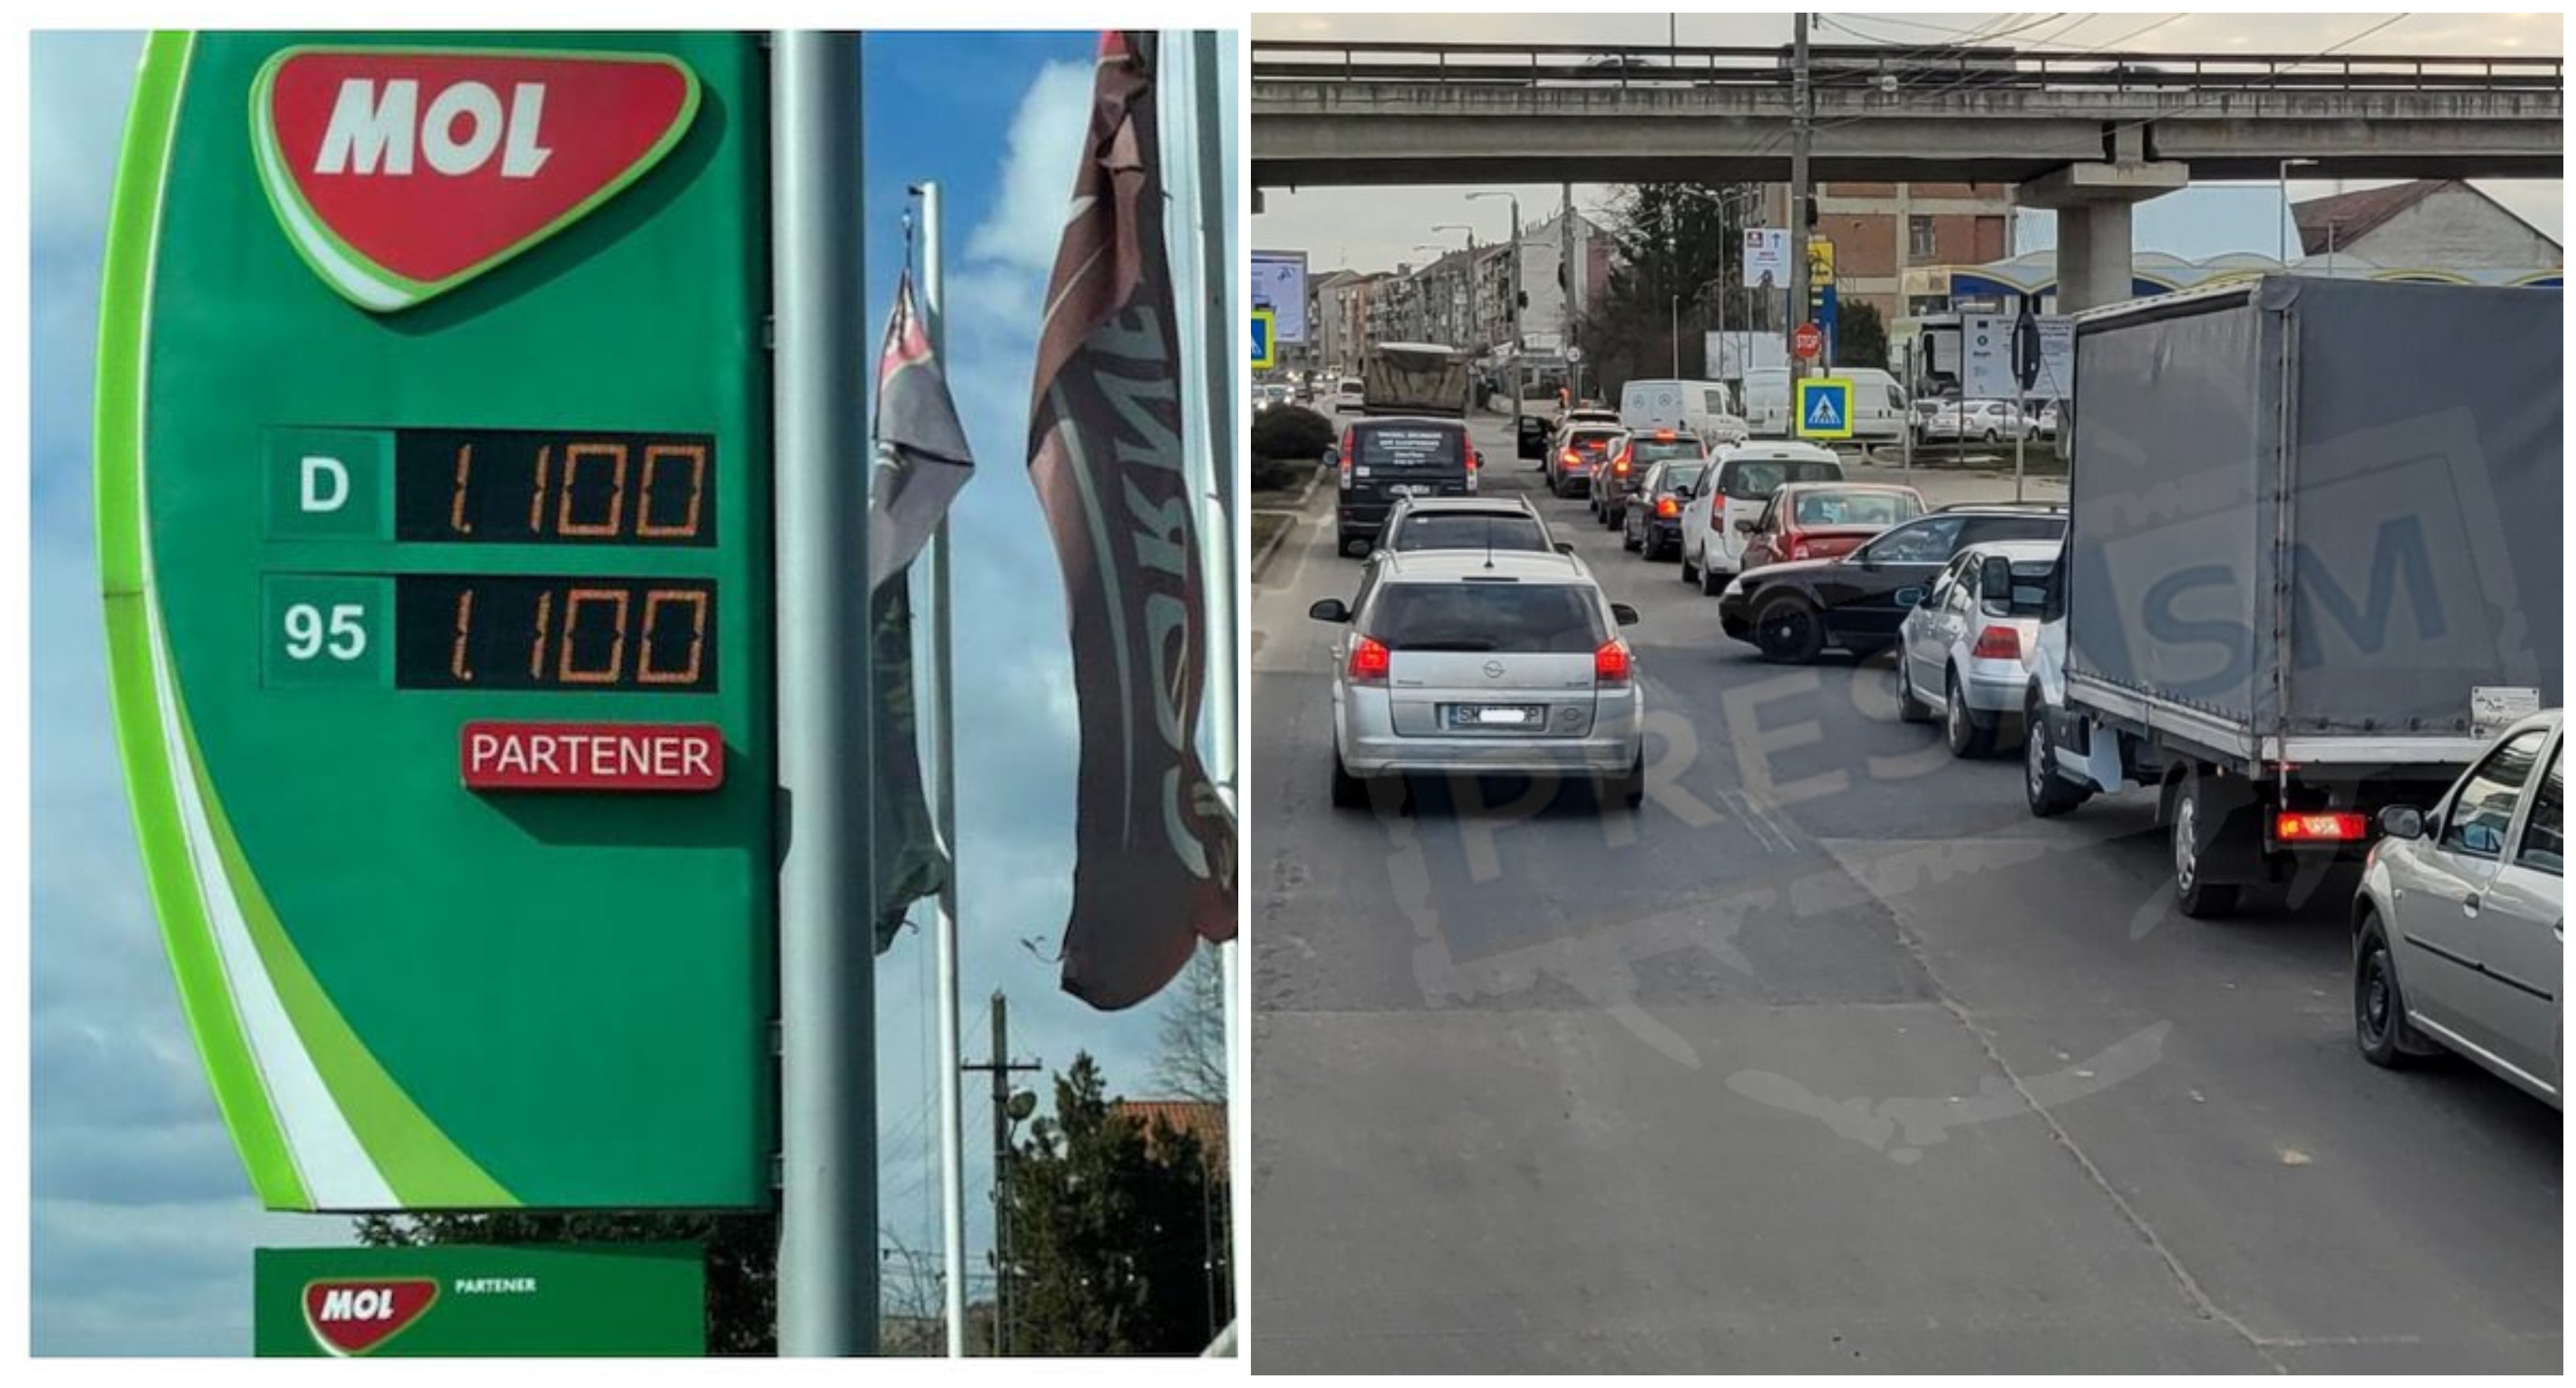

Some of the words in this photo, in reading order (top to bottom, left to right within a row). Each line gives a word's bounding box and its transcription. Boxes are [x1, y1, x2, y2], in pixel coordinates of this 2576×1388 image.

[314, 78, 554, 177] MOL
[1796, 335, 1819, 349] STOP
[301, 457, 349, 512] D
[451, 443, 706, 537] 1.100
[284, 604, 366, 660] 95
[451, 589, 707, 683] 1.100
[471, 735, 711, 776] PARTENER
[319, 1289, 394, 1322] MOL
[455, 1278, 536, 1293] PARTENER
